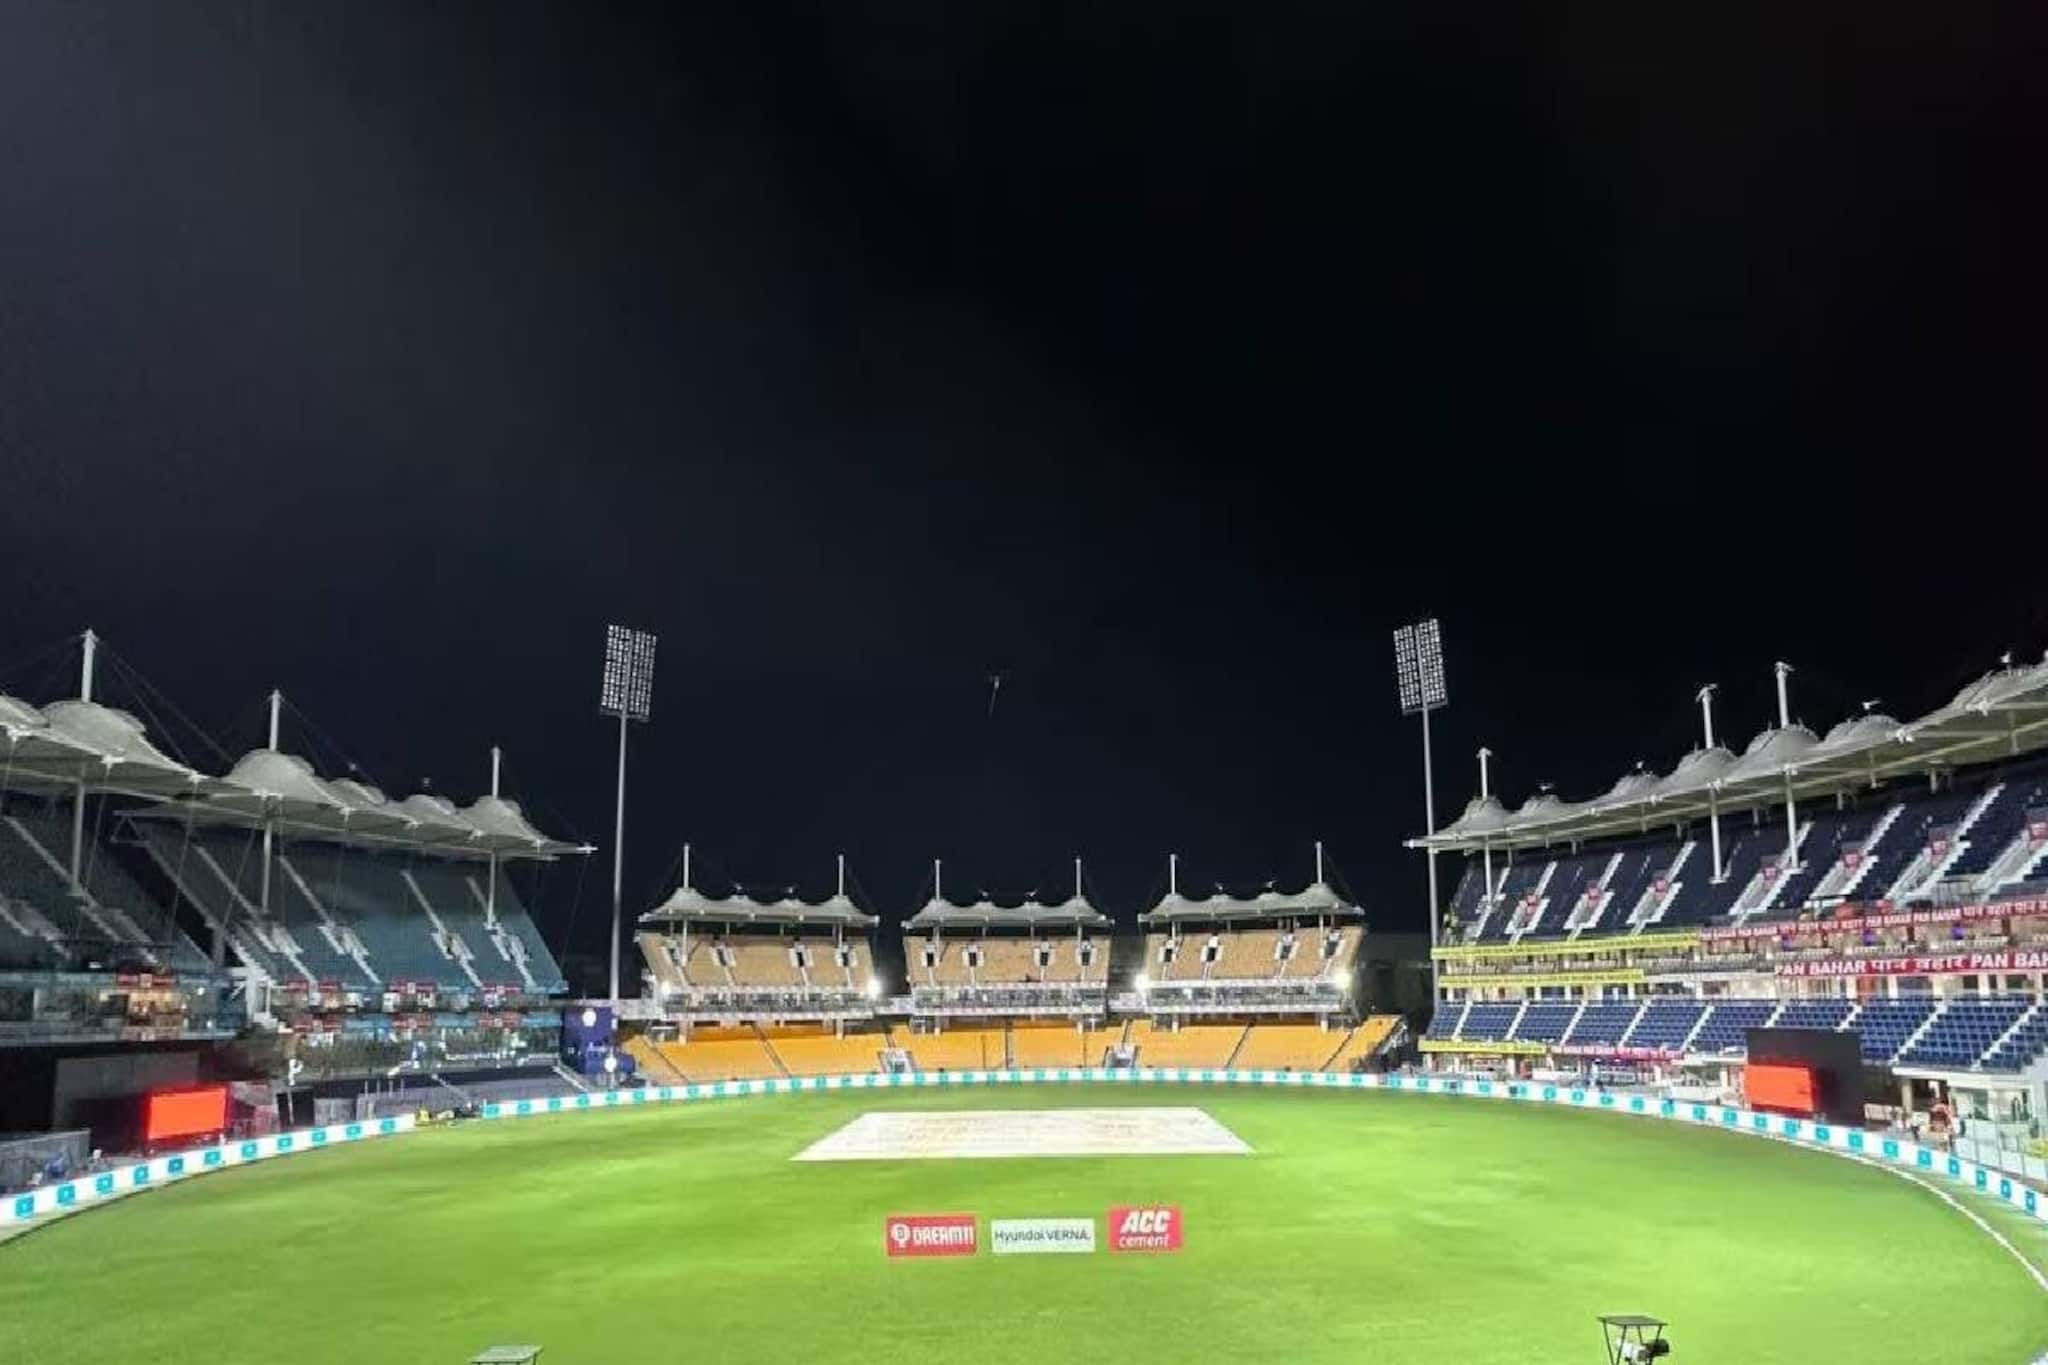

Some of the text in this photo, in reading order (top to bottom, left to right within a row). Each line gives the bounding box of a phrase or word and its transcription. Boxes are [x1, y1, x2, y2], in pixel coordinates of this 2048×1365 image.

[1774, 959, 1866, 976] PAN BAHAR
[1970, 952, 2009, 969] PAN
[1119, 1209, 1171, 1234] ACC
[1118, 1233, 1170, 1249] cement
